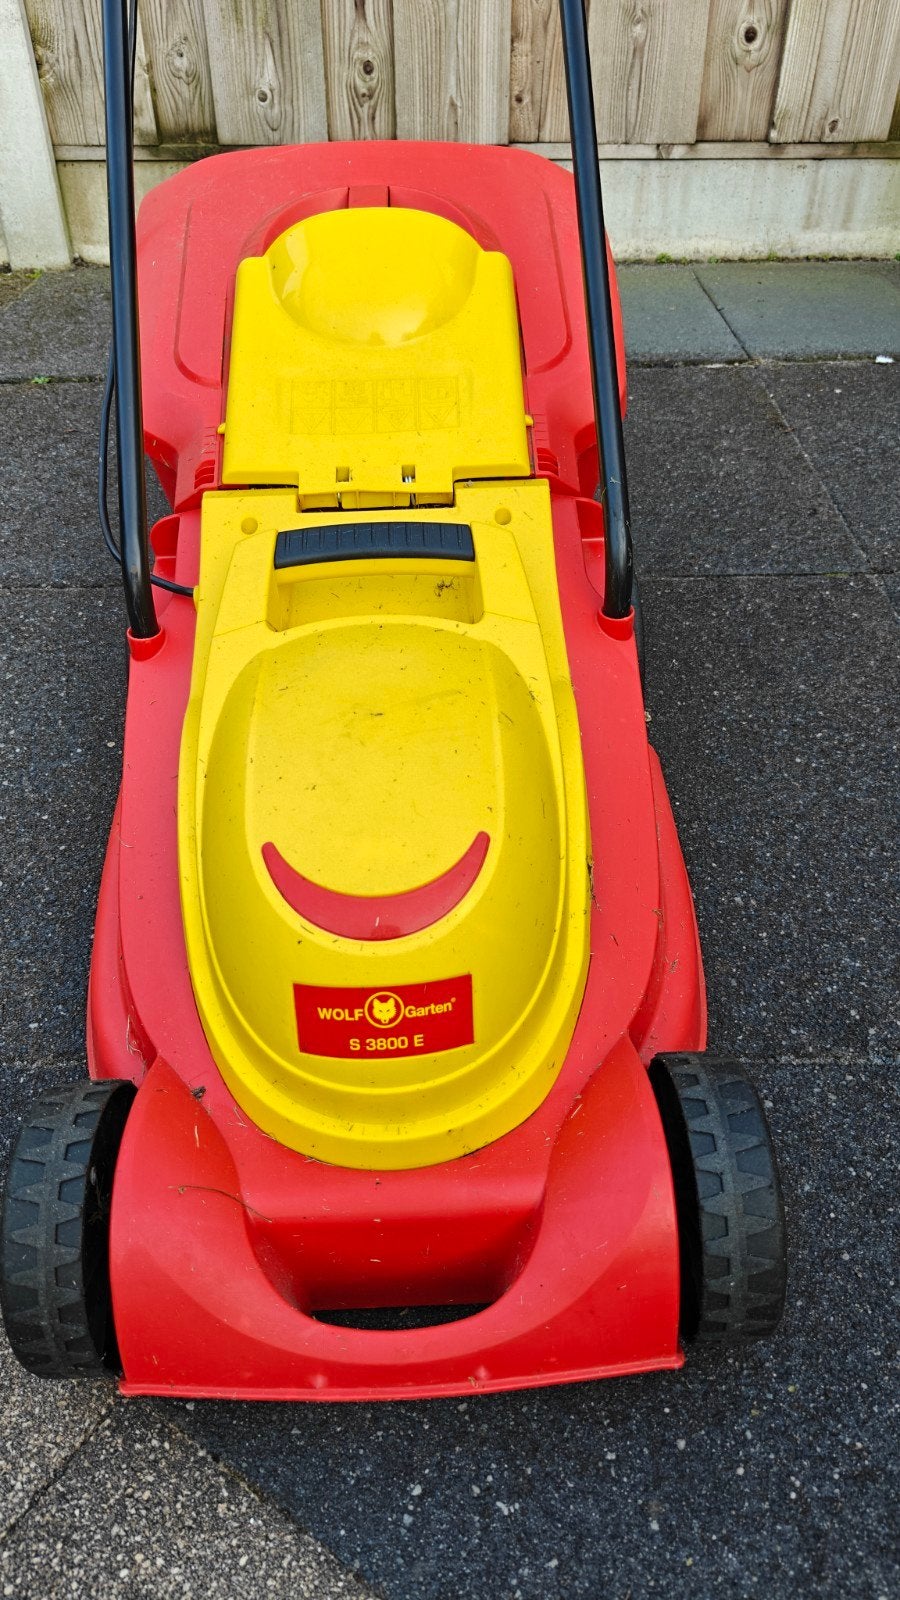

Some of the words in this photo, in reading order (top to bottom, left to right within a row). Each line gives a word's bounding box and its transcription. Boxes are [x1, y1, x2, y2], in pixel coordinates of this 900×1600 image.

[317, 1006, 364, 1021] WOLF
[404, 1000, 453, 1018] Garten
[349, 1038, 361, 1051] S
[365, 1036, 409, 1051] 3800
[413, 1034, 424, 1047] E
